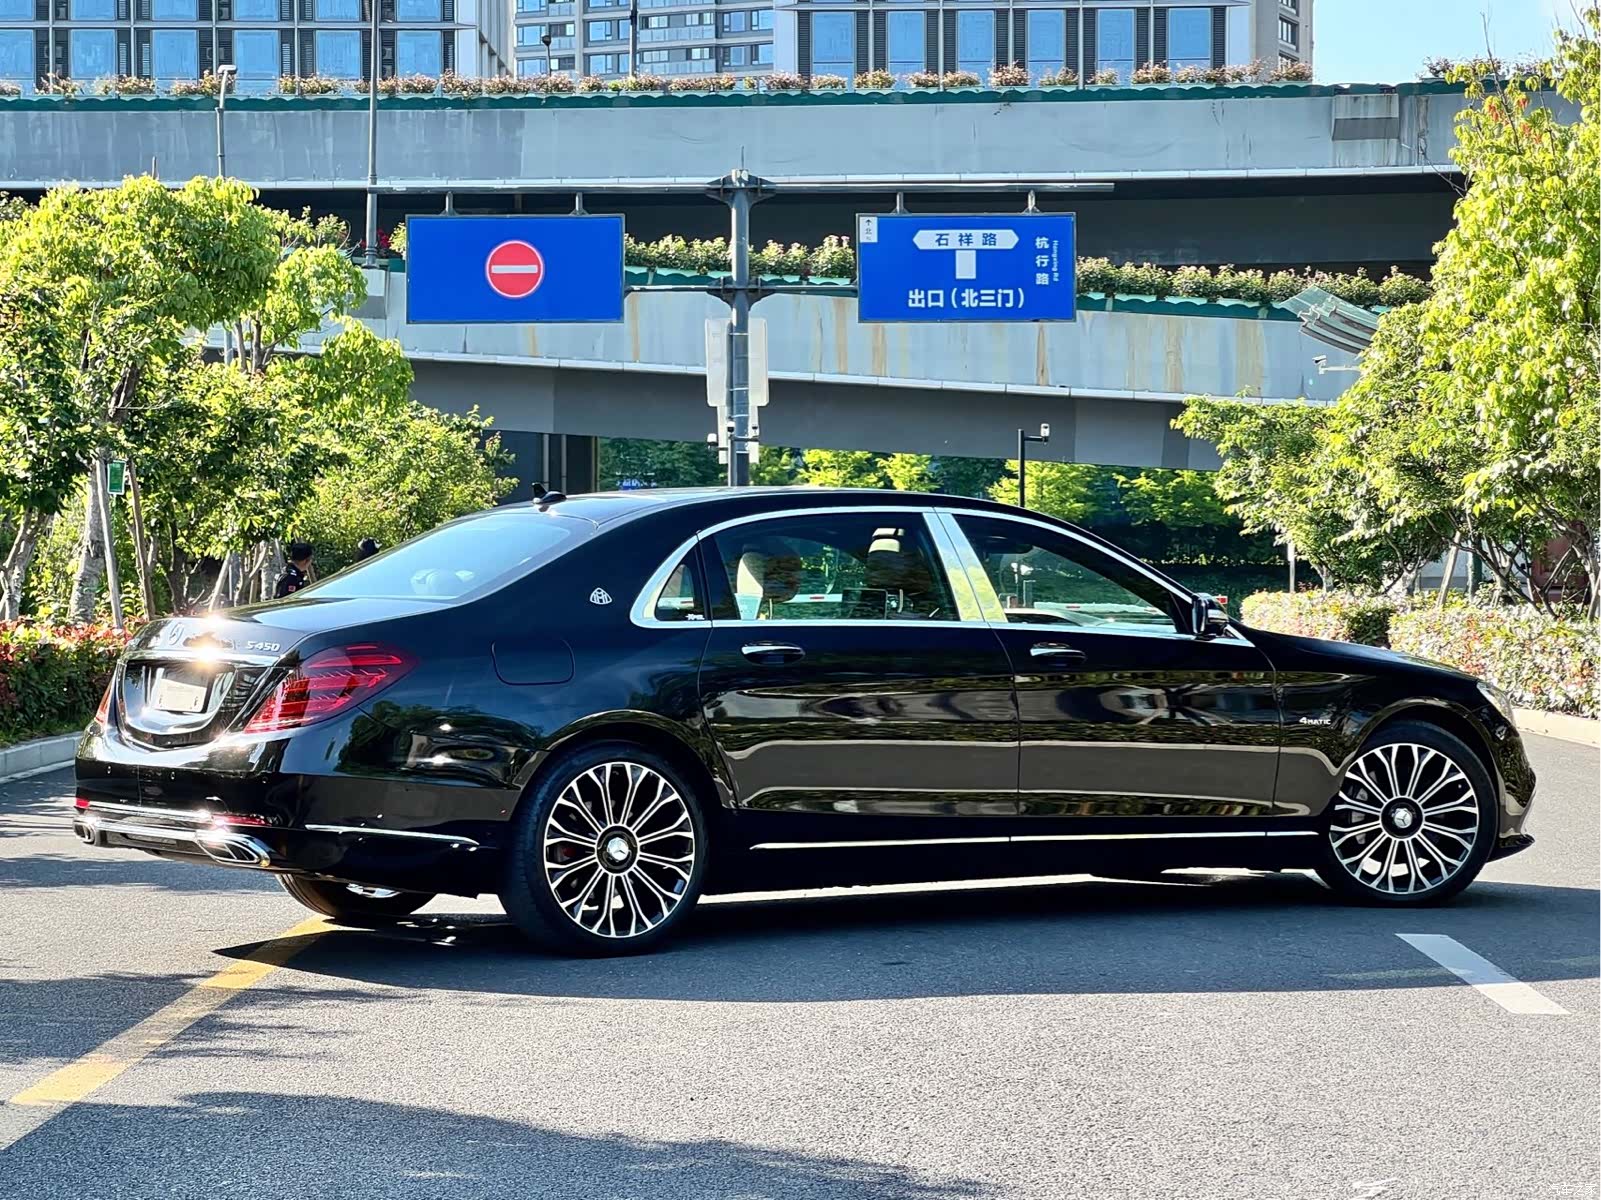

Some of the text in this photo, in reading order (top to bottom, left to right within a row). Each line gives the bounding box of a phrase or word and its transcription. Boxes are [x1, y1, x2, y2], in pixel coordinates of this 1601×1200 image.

[935, 232, 997, 247] 石祥路
[1035, 236, 1050, 286] 杭行路
[246, 640, 281, 652] S450
[1299, 716, 1332, 725] 4MATIC
